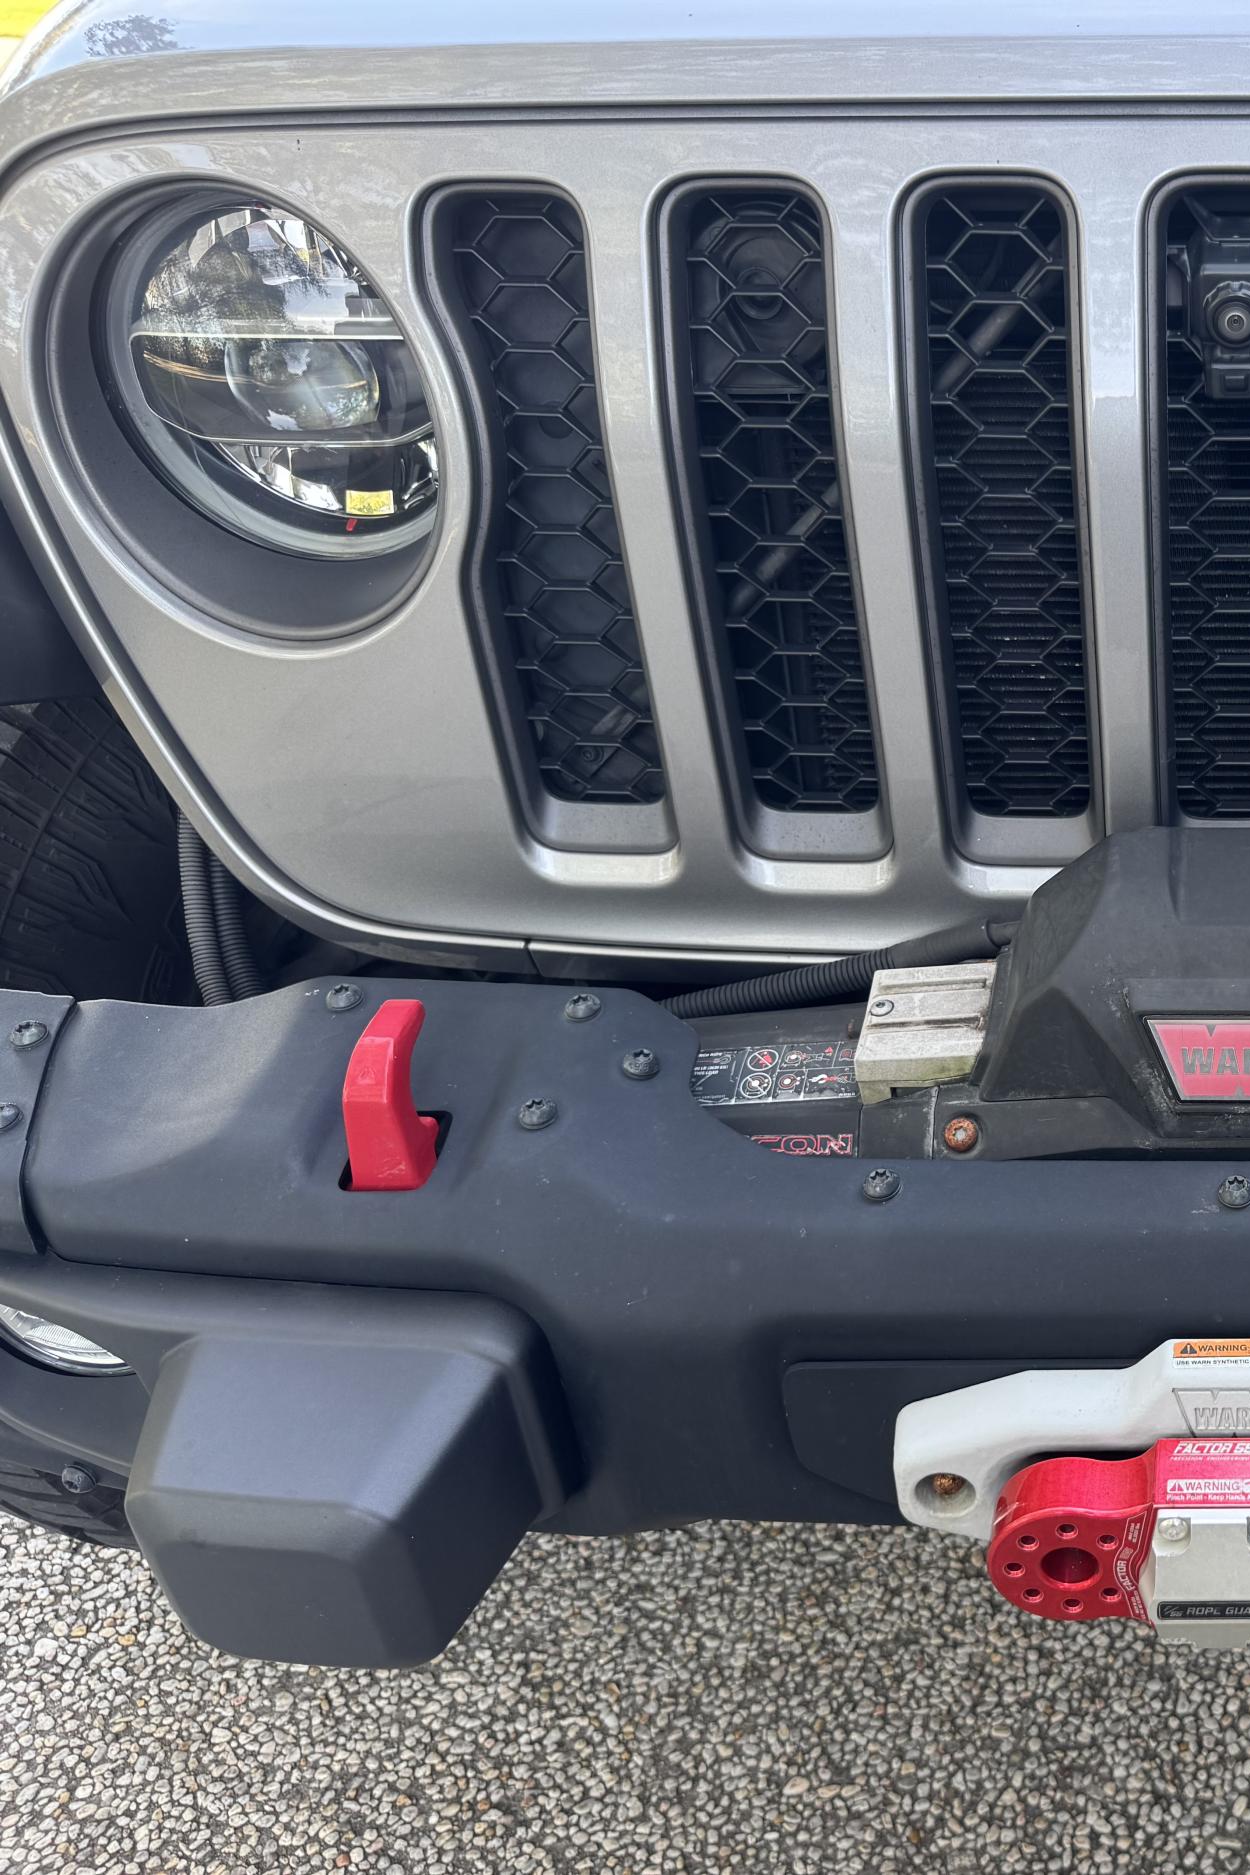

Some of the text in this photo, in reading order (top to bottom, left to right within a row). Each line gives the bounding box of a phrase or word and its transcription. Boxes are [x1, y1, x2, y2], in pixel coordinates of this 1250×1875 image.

[1198, 1344, 1248, 1352] WARNING
[1173, 1442, 1233, 1454] FACTOR
[1185, 1481, 1240, 1492] WARNING
[1207, 1494, 1225, 1502] Keep
[1116, 1560, 1136, 1591] FACTOR
